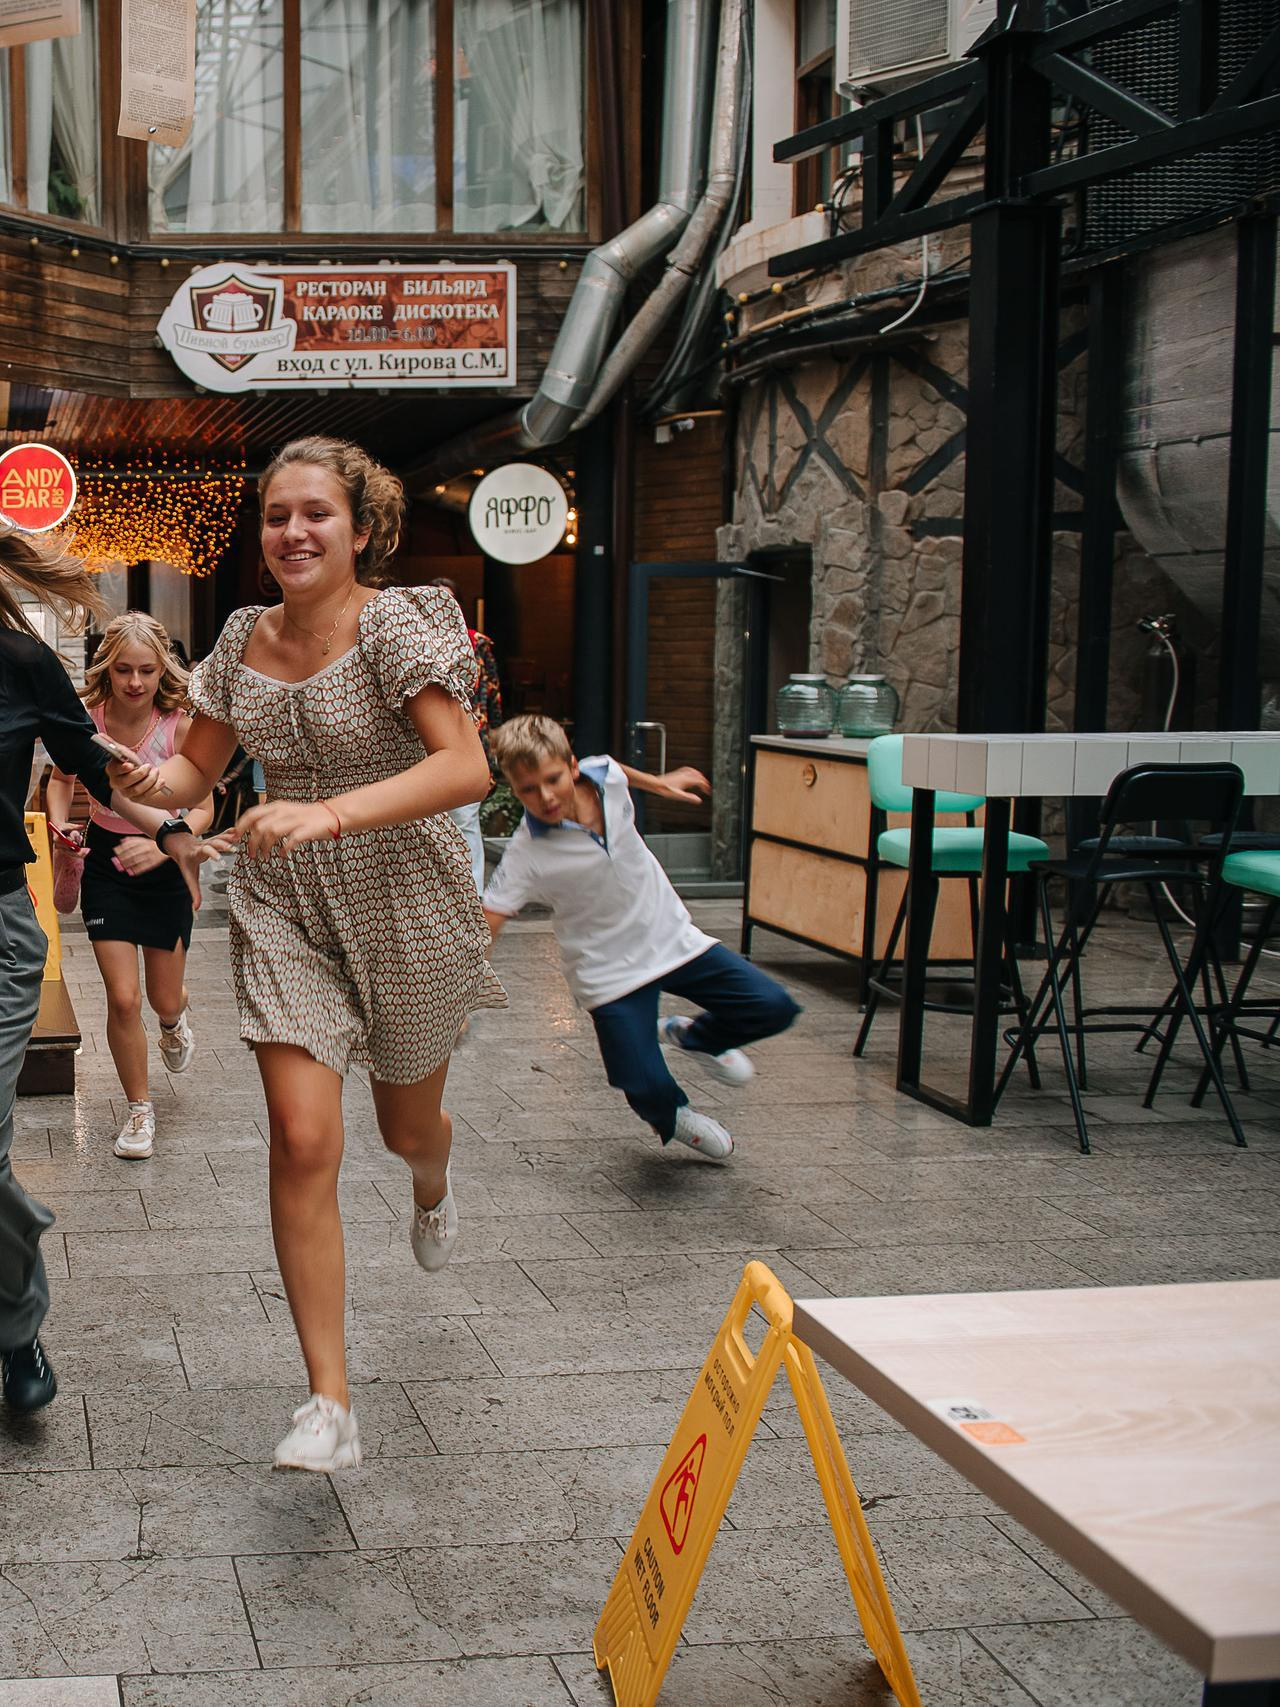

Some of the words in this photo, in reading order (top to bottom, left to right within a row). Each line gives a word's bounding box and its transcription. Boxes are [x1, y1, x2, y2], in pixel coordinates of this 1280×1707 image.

[296, 280, 387, 297] РЕСТОРАН
[403, 279, 487, 298] БИЛЬЯРД
[303, 304, 383, 321] КАРАОКЕ
[393, 303, 499, 322] ДИСКОТЕКА
[277, 357, 325, 375] вход
[329, 358, 340, 371] с
[345, 357, 373, 376] ул.
[379, 353, 456, 375] Кирова
[462, 351, 503, 369] С.М.
[1, 467, 64, 488] ANDY
[2, 488, 50, 509] BAR
[485, 495, 556, 529] ЯФФО
[714, 1358, 740, 1414] ОСТОРОЖНО
[644, 1536, 665, 1600] CAUTION
[634, 1548, 646, 1582] WET
[642, 1578, 660, 1630] FLOOR
